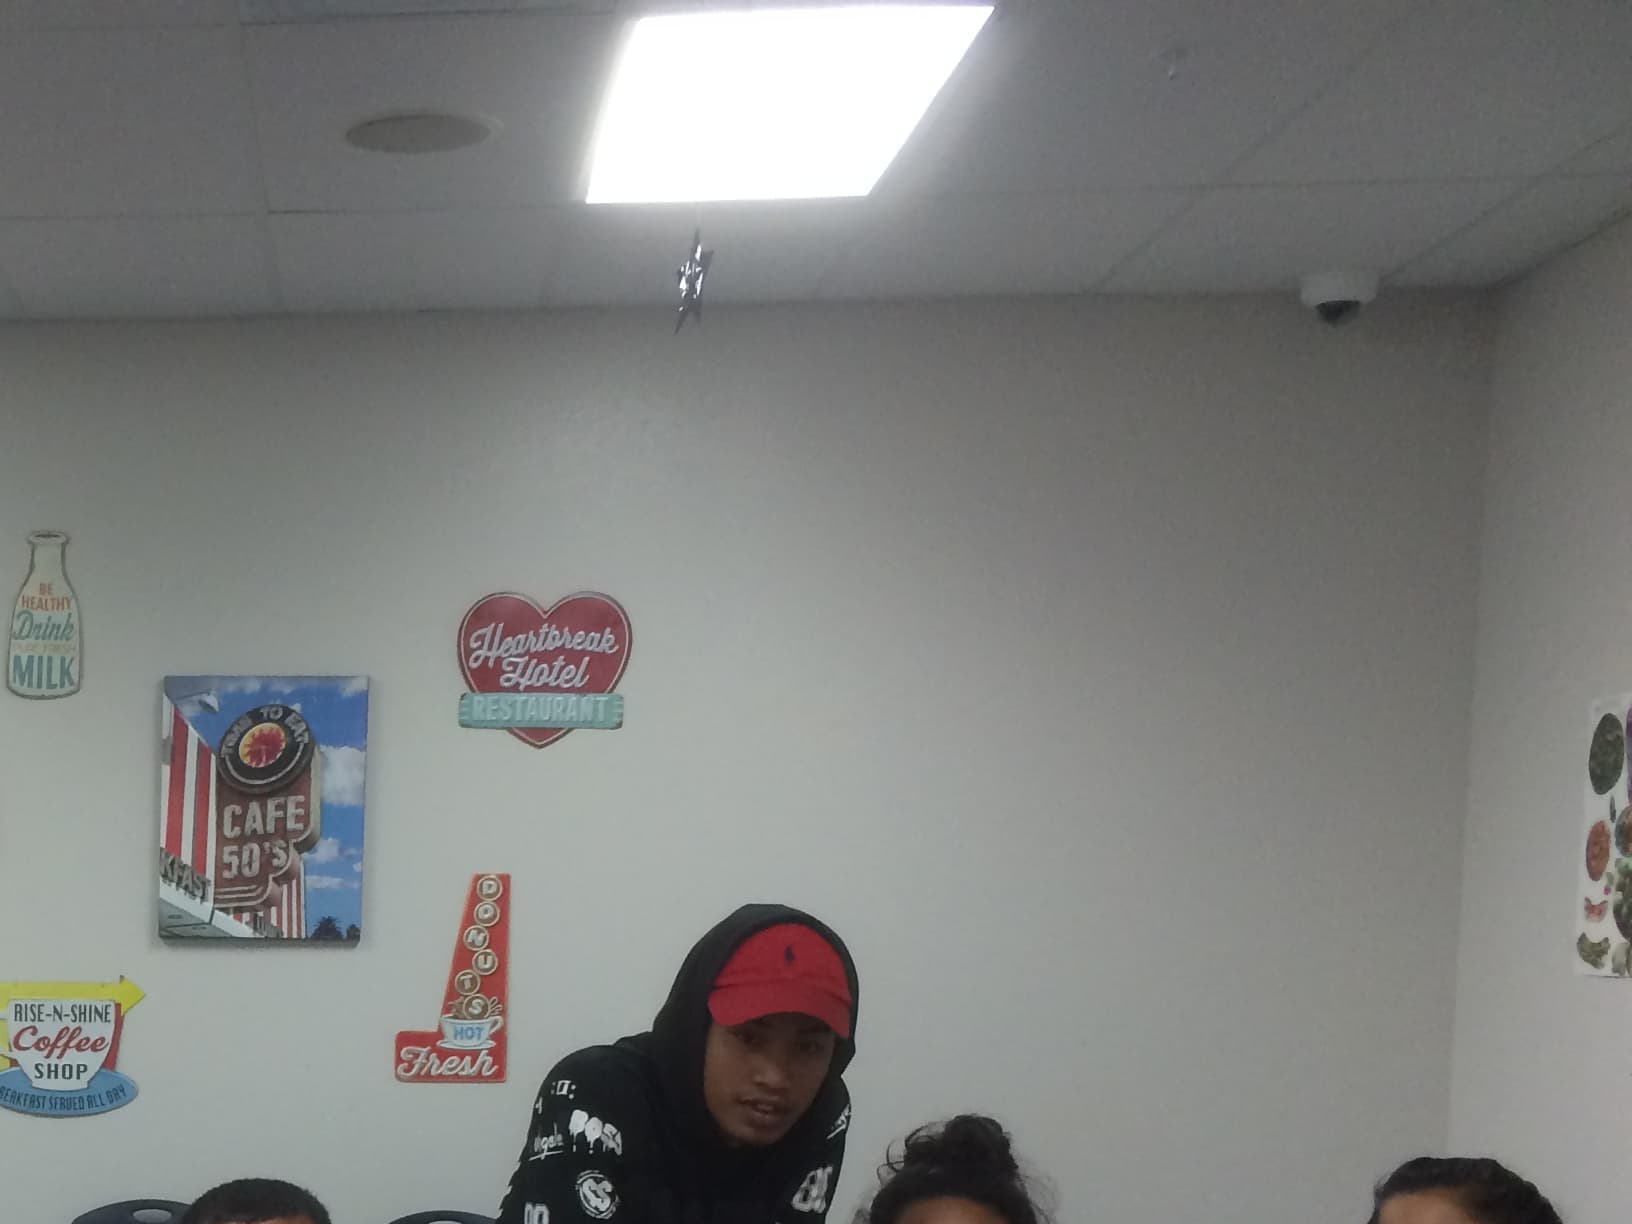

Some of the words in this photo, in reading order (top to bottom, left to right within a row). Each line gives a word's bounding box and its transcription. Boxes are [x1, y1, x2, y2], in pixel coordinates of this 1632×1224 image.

[39, 583, 53, 595] BE
[21, 595, 72, 612] HEALTHY
[12, 610, 74, 641] Drink
[468, 622, 620, 669] Heartbreak
[12, 655, 74, 689] MILK
[499, 655, 590, 691] Hotel
[260, 706, 283, 721] TO
[471, 695, 609, 722] RESTAURANT
[223, 795, 305, 839] CAFE
[222, 840, 288, 879] 50'S
[13, 1003, 112, 1023] RISE-N-SHINE
[12, 1025, 109, 1060] Coffee
[453, 1026, 483, 1041] HOT
[34, 1063, 88, 1081] SHOP
[396, 1047, 498, 1077] Fresh
[48, 1095, 85, 1111] SERVED
[87, 1095, 106, 1109] ALL
[105, 1086, 127, 1104] DAY
